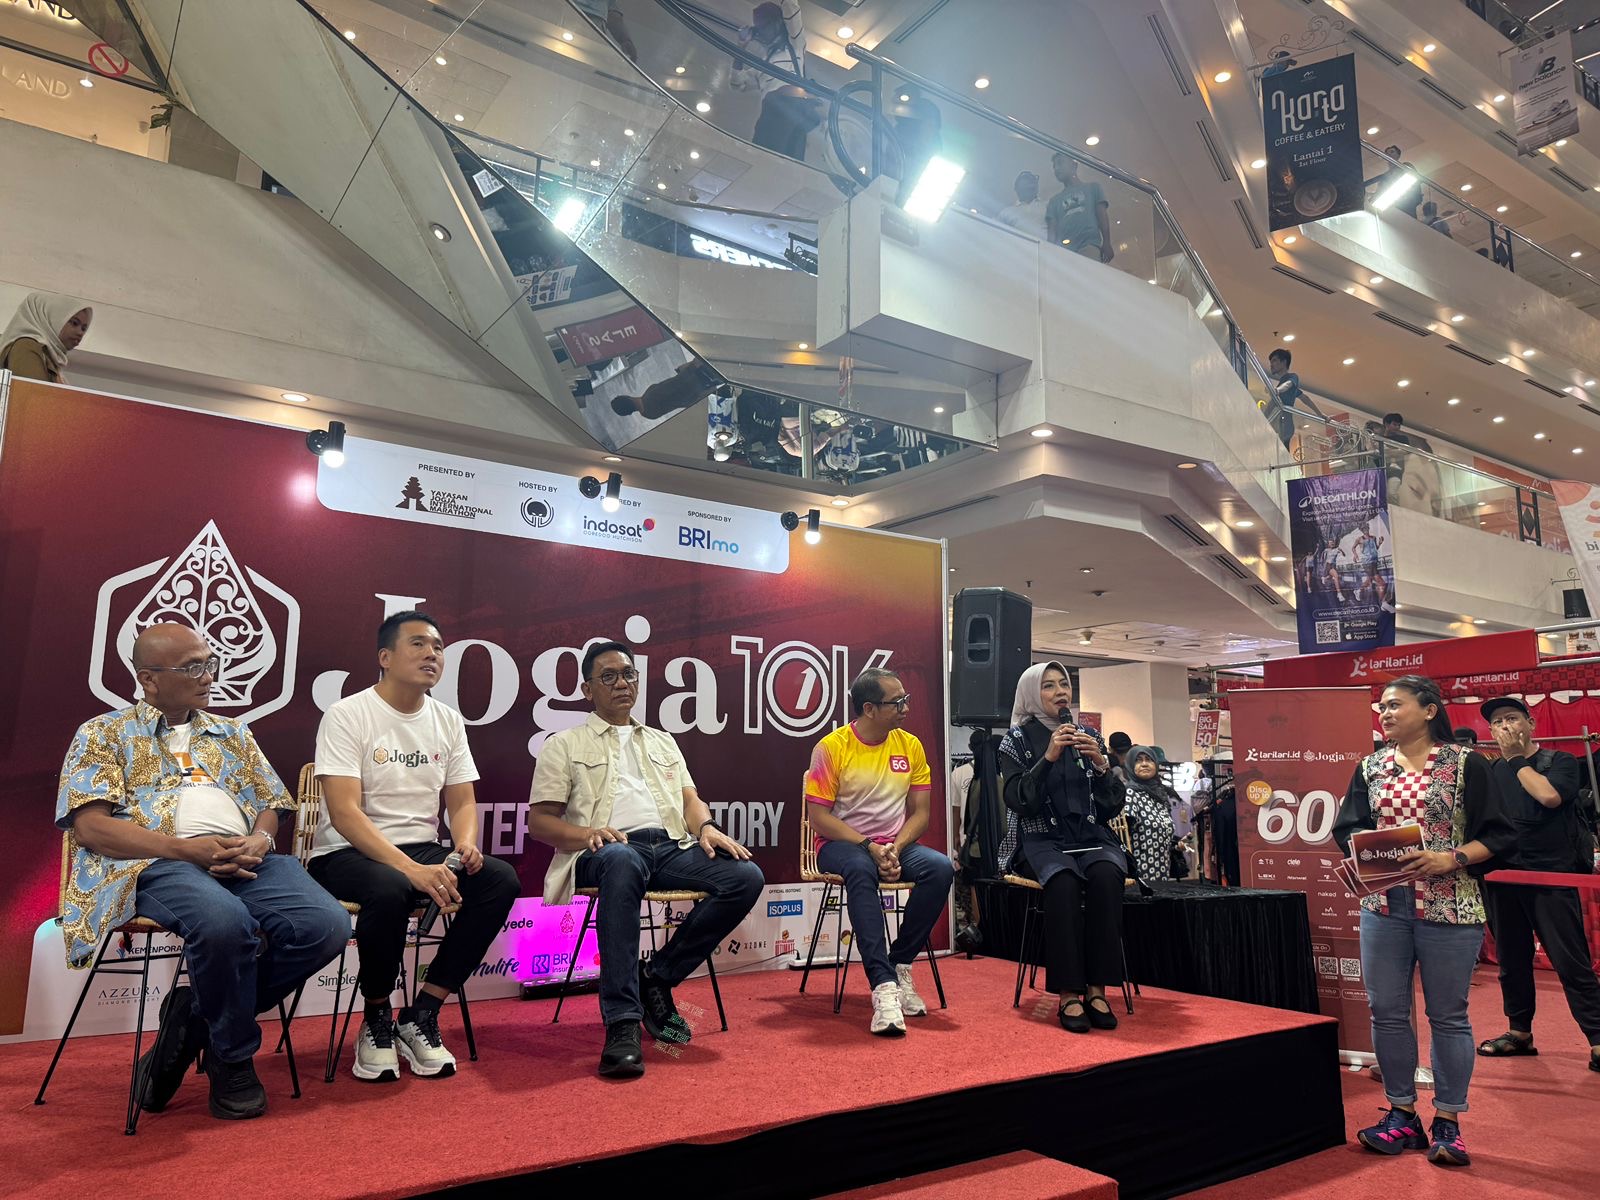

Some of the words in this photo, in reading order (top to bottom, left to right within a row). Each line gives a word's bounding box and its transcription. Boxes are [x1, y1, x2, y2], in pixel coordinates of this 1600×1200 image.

[1274, 133, 1304, 147] COFFEE
[1306, 131, 1314, 139] &
[1315, 122, 1346, 137] EATERY
[1293, 148, 1324, 162] Lantai
[418, 464, 463, 477] PRESENTED
[465, 471, 475, 479] BY
[518, 481, 547, 492] HOSTED
[430, 489, 468, 501] YAYASAN
[430, 496, 456, 504] JOGJA
[600, 495, 631, 506] PRED
[1314, 489, 1377, 505] DECATHLON
[430, 501, 493, 516] INTERNATIONAL
[430, 506, 476, 518] MARATHON
[687, 510, 723, 522] SPONSORED
[583, 515, 642, 538] indosat
[612, 534, 643, 543] HUTCHISON
[679, 526, 739, 554] BRImo
[1369, 653, 1423, 670] larilari.id
[1470, 672, 1519, 684] larilari.id
[1200, 715, 1212, 724] BIG
[1198, 723, 1217, 731] SALE
[390, 749, 429, 768] Jogja
[1259, 750, 1300, 759] larilari.id
[1315, 751, 1345, 763] Jogja
[892, 760, 908, 770] 5G
[1249, 785, 1268, 794] Disc
[1261, 791, 1270, 799] to
[1257, 789, 1345, 845] 60
[1372, 847, 1403, 860] Jogja
[769, 904, 801, 915] ISOPLUS
[472, 958, 520, 977] nulife
[552, 965, 584, 973] Insurce
[98, 986, 161, 999] AZZURA
